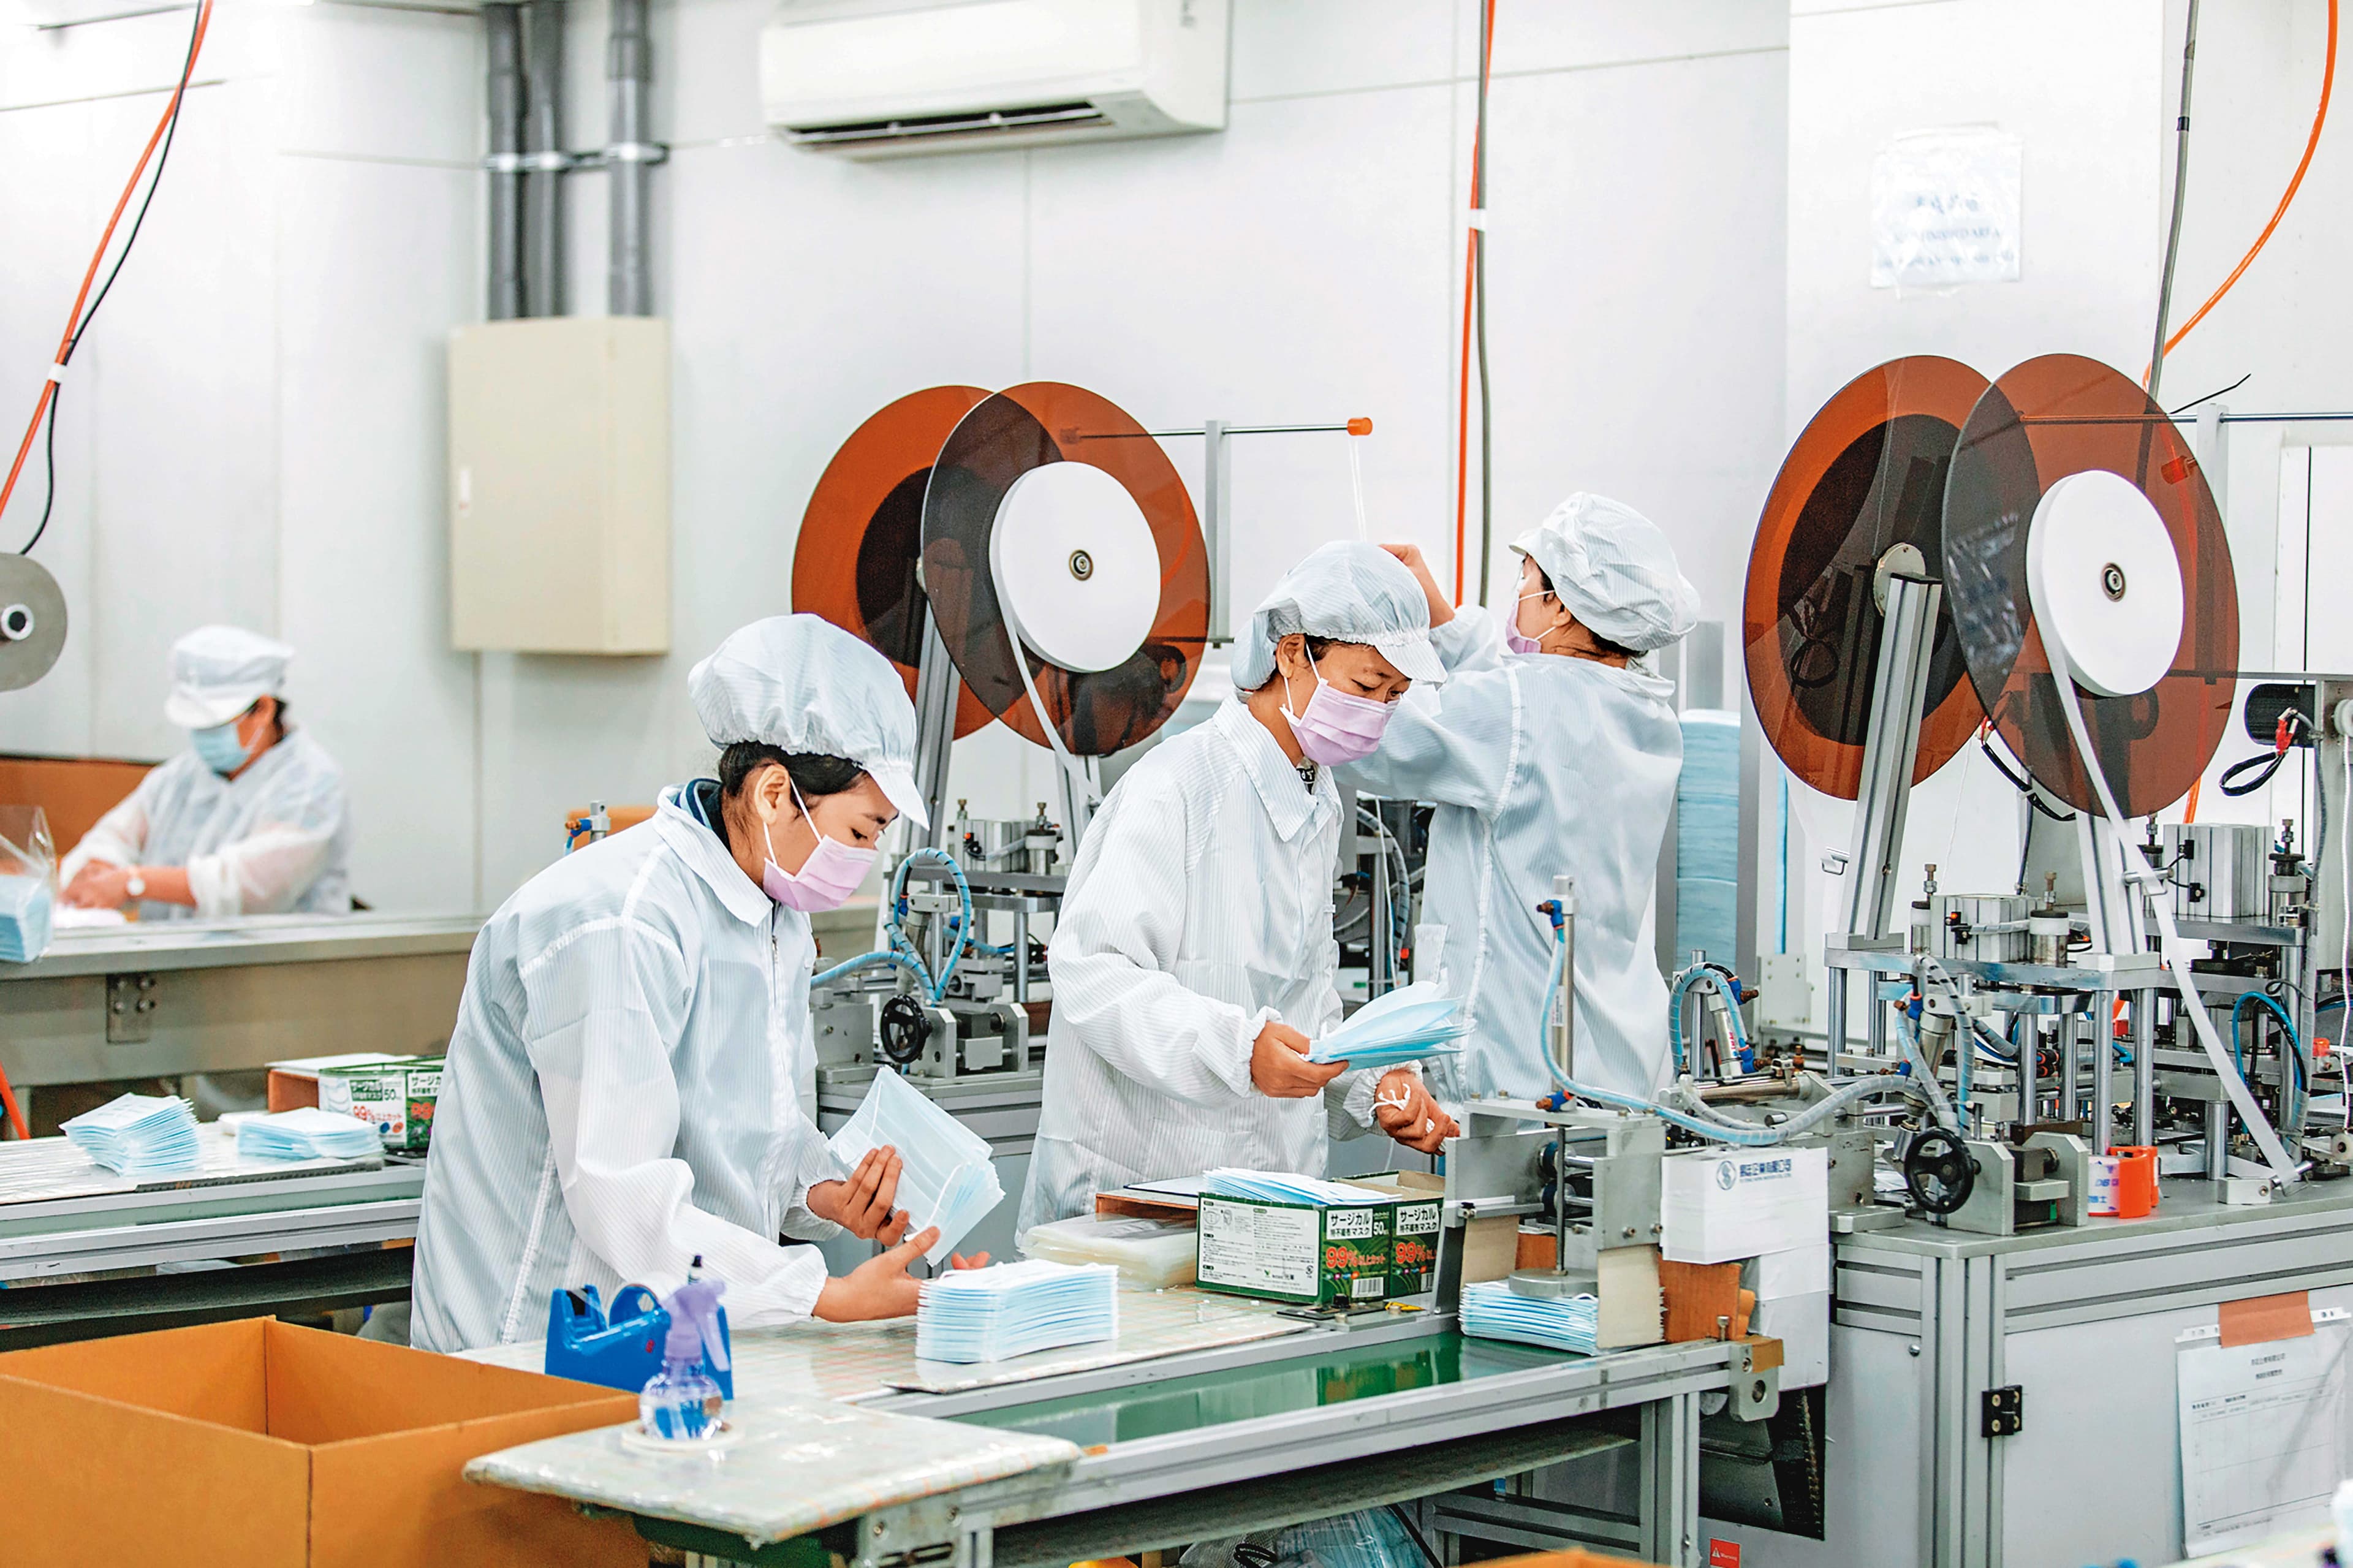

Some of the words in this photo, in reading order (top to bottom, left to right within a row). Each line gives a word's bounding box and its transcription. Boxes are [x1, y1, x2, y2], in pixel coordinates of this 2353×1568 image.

[1330, 1211, 1371, 1227] サージカル
[1400, 1207, 1436, 1223] サージカル
